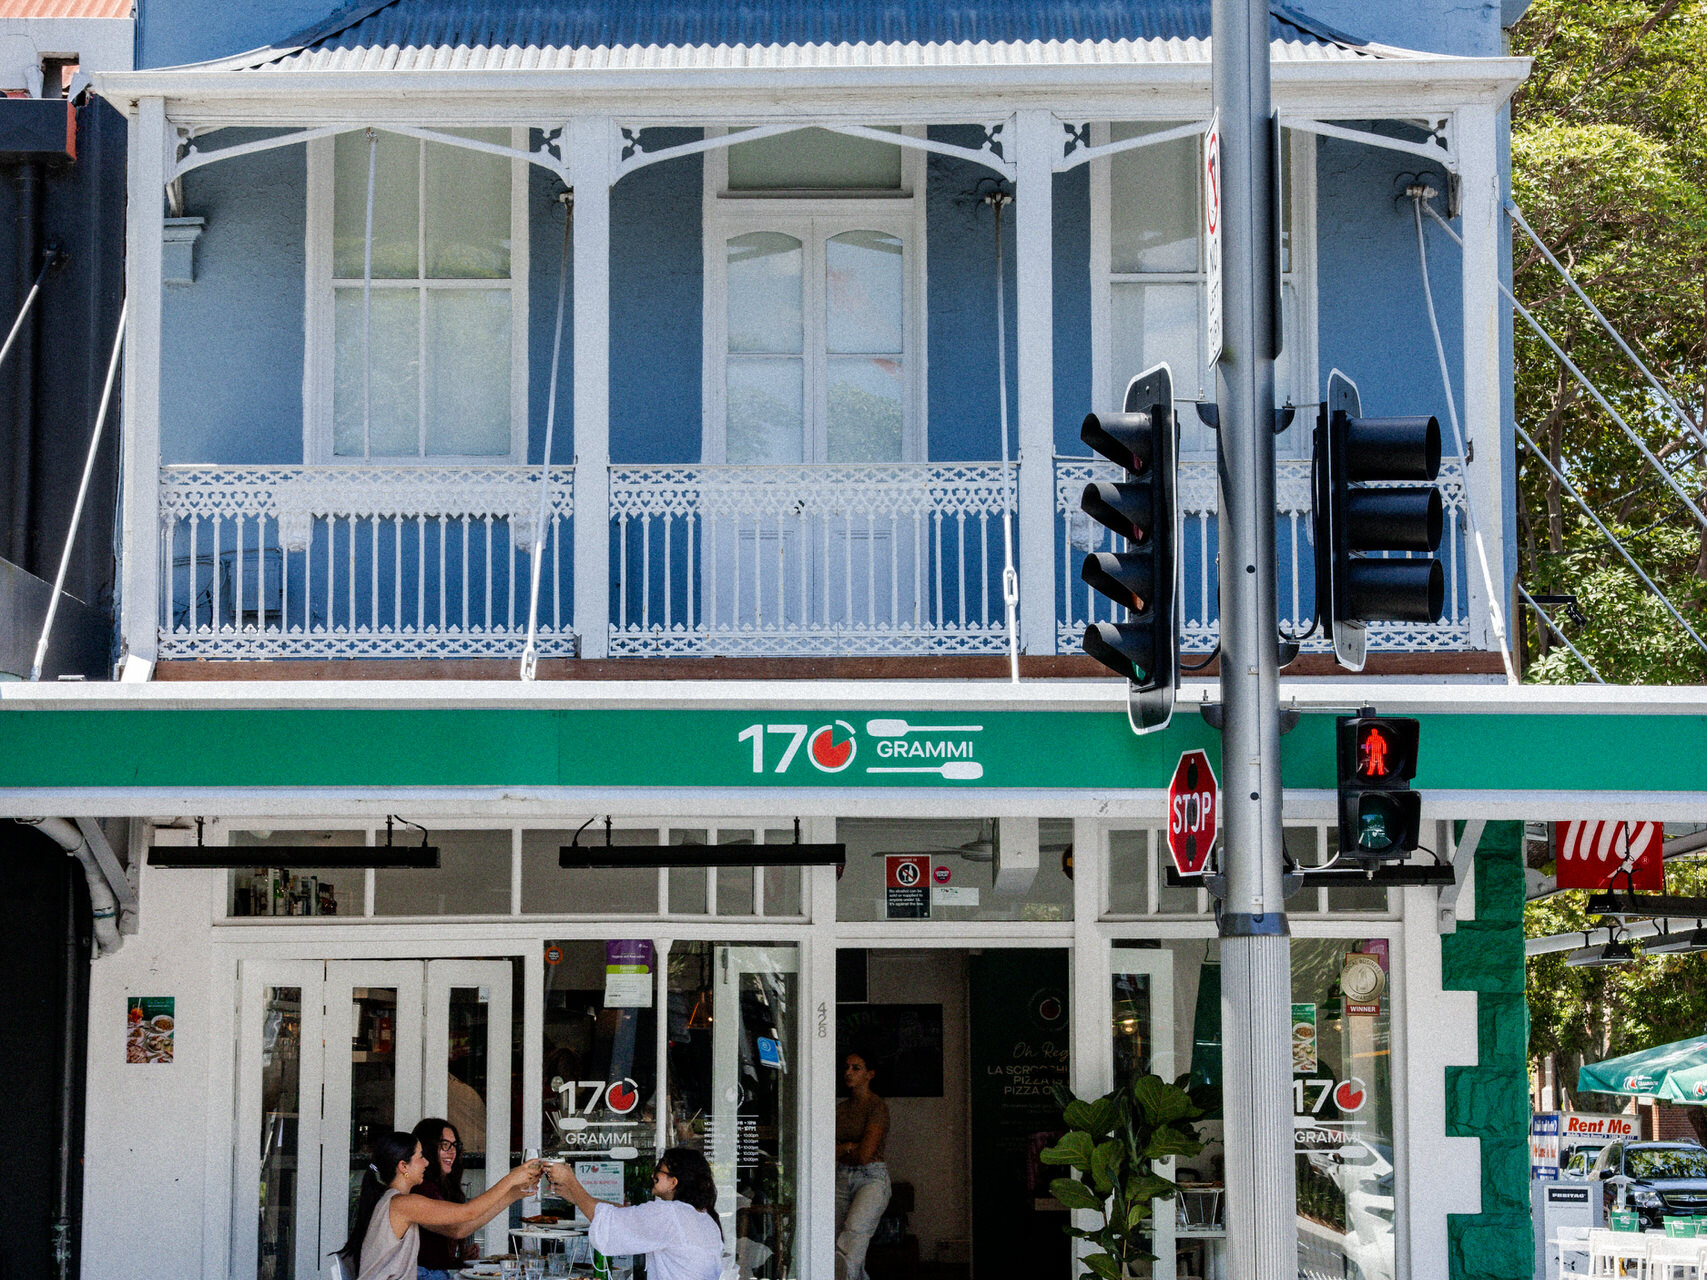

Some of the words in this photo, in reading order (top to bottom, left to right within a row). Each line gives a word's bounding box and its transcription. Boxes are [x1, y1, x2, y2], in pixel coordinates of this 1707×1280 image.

[876, 740, 974, 758] GRAMMI
[1172, 791, 1212, 835] STOP
[817, 1001, 828, 1038] 428
[987, 1065, 1003, 1075] LA
[558, 1077, 639, 1114] 170
[1004, 1086, 1040, 1096] PIZZA
[1568, 1117, 1604, 1133] Rent
[1608, 1119, 1632, 1135] Me
[565, 1132, 632, 1144] GRAMMI
[1294, 1131, 1361, 1143] GRAMMI
